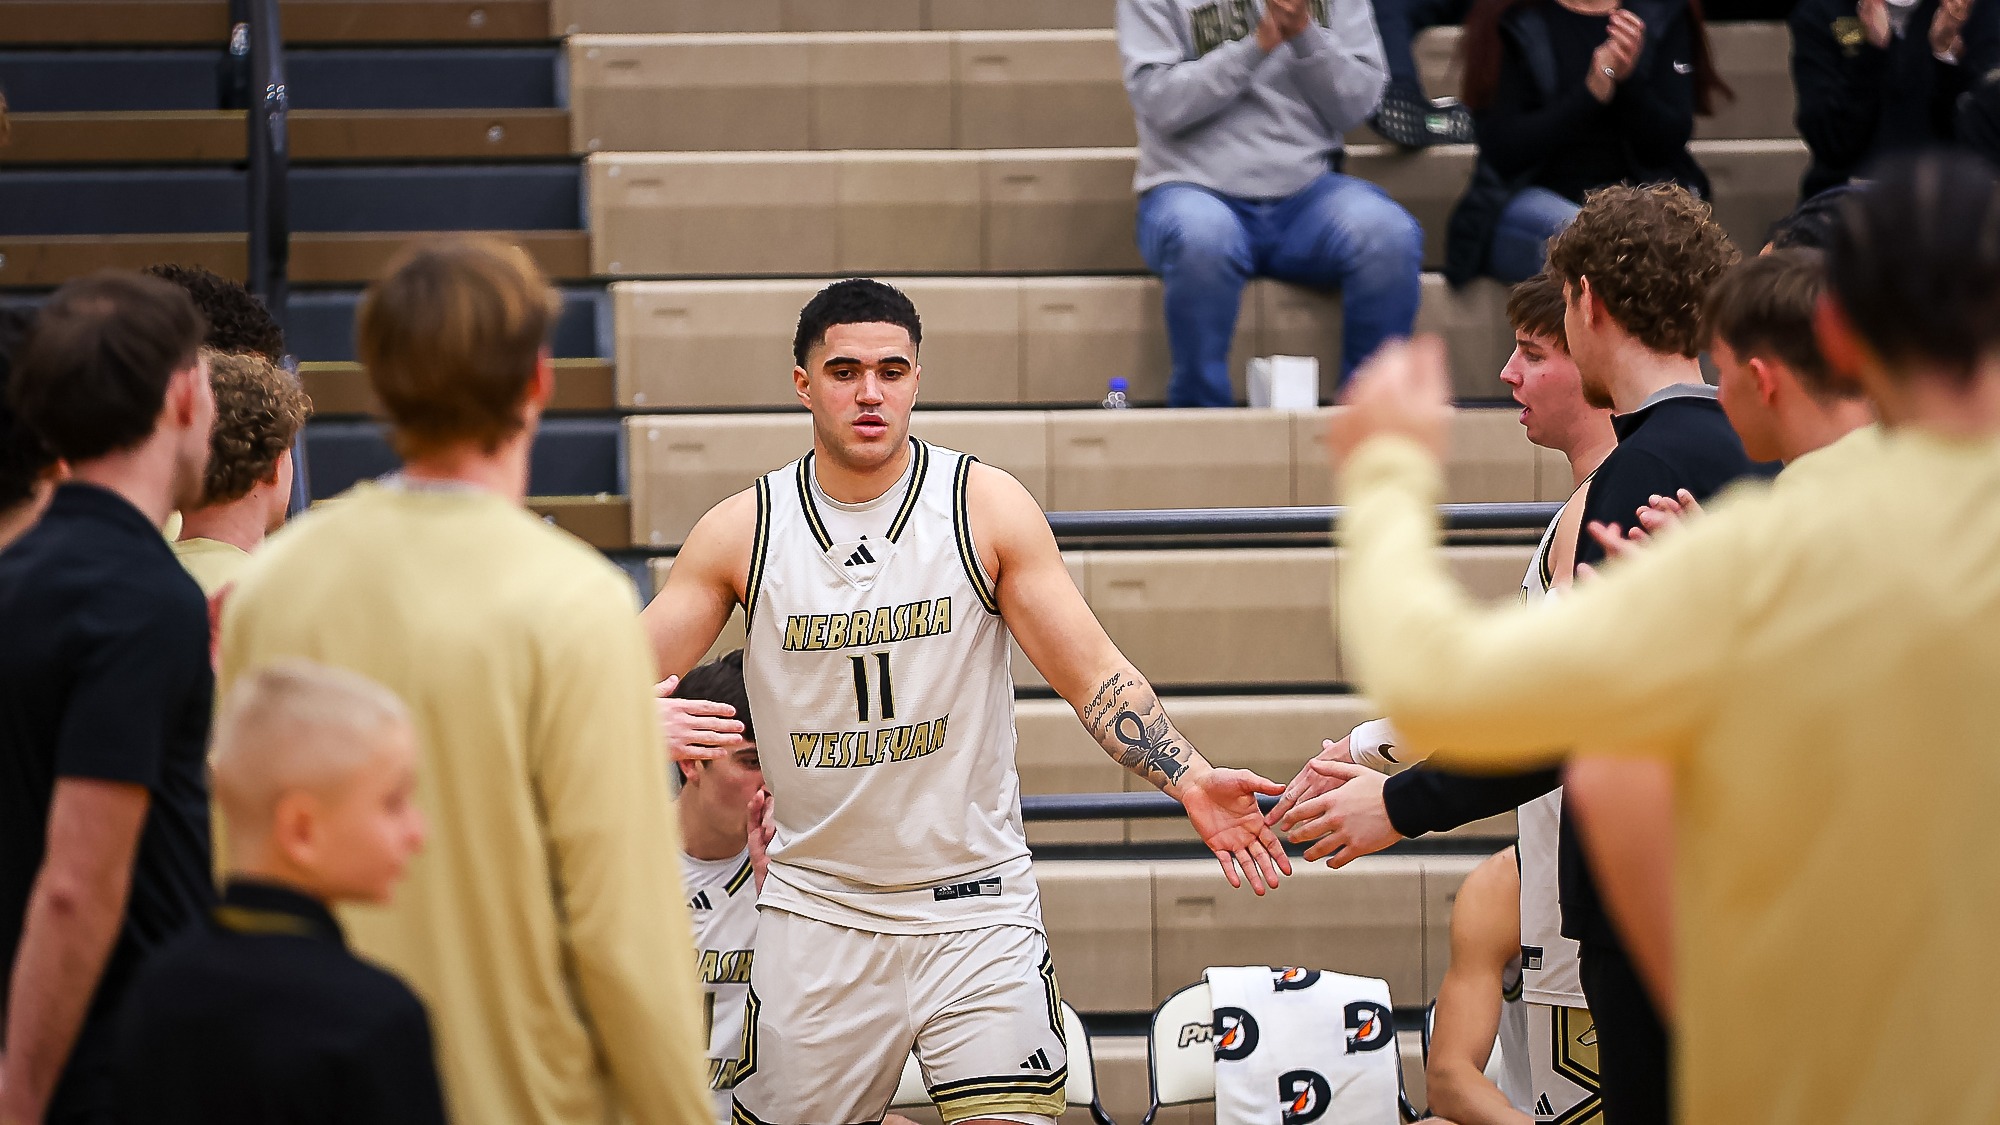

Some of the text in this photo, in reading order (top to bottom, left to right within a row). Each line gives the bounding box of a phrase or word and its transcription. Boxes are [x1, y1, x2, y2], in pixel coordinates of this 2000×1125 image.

[782, 596, 952, 651] NEBRASKA
[846, 650, 896, 723] 11
[789, 712, 950, 769] WESLEYAN
[1178, 1022, 1213, 1047] Pr
